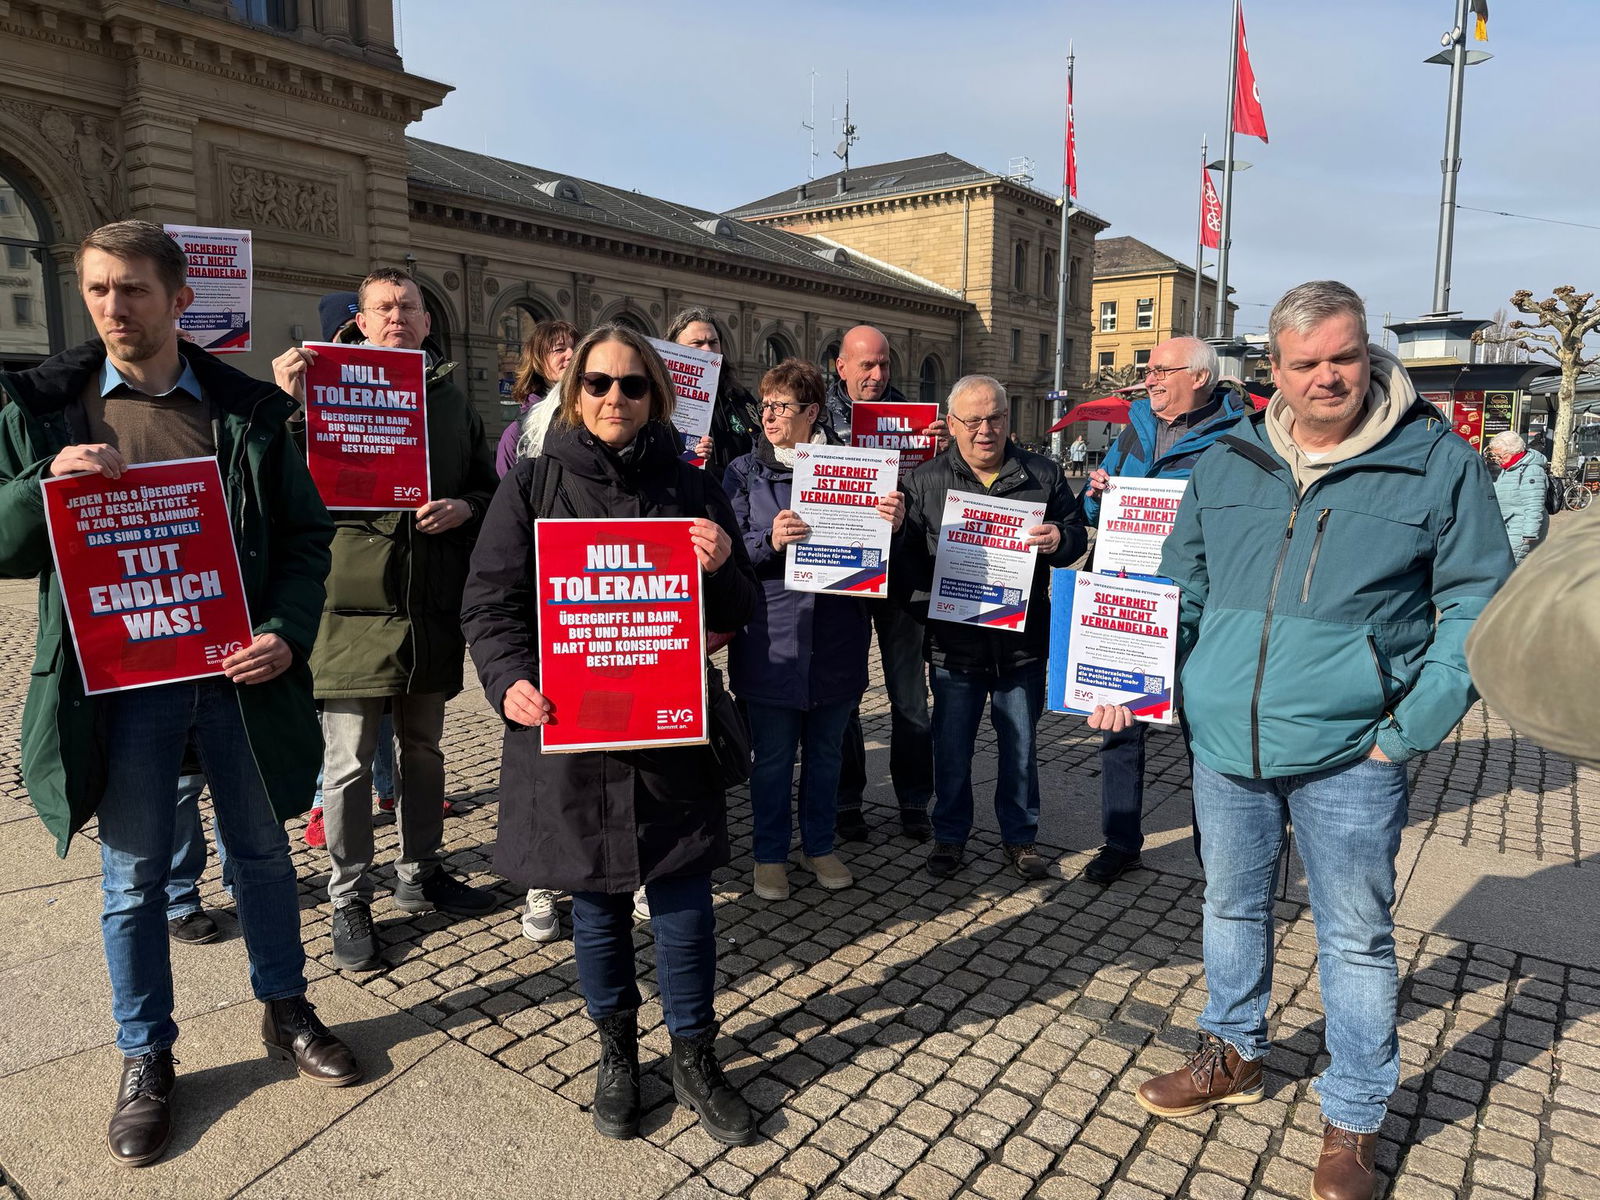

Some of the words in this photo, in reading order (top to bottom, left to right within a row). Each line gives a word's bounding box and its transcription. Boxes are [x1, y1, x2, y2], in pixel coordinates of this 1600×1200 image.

[184, 243, 237, 254] SICHERHEIT
[189, 255, 204, 264] IST
[208, 256, 234, 266] NICHT
[189, 267, 246, 278] RHANDELBAR
[664, 359, 704, 376] HERHEIT
[341, 365, 390, 385] NULL
[672, 373, 699, 387] NICHT
[313, 386, 417, 409] TOLERANZ!
[675, 386, 709, 401] DELBAR
[321, 410, 373, 423] ÜBERGRIFFE
[376, 416, 384, 424] IN
[387, 416, 412, 426] BAHN,
[877, 417, 912, 431] NULL
[328, 423, 345, 432] BUS
[348, 424, 365, 433] UND
[368, 425, 406, 435] BAHNHOF
[317, 433, 340, 442] HART
[343, 434, 360, 443] UND
[363, 435, 418, 445] KONSEQUENT
[857, 435, 930, 449] TOLERANZ!
[342, 444, 394, 454] BESTRAFEN!
[814, 464, 879, 478] SICHERHEIT
[394, 487, 421, 496] EVG
[818, 478, 836, 489] IST
[839, 480, 872, 492] NICHT
[66, 494, 102, 509] JEDEN
[105, 491, 127, 503] TAG
[130, 490, 138, 499] 8
[140, 482, 206, 498] ÜBERGRIFFE
[801, 491, 885, 506] VERHANDELBA
[1121, 495, 1181, 509] SICHERHEIT
[80, 506, 102, 518] AUF
[106, 496, 189, 515] BESCHÄFTIGTE
[77, 521, 90, 532] IN
[93, 517, 119, 529] ZUG,
[121, 515, 148, 526] BUS,
[150, 507, 204, 522] BAHNHOF.
[963, 508, 1024, 526] SICHERHEIT
[1124, 509, 1141, 519] IST
[1144, 510, 1176, 522] NICHT
[88, 534, 112, 546] DAS
[114, 529, 141, 542] SIND
[144, 529, 151, 539] 8
[154, 526, 168, 538] ZU
[170, 522, 200, 536] VIEL!
[965, 520, 983, 532] IST
[985, 523, 1017, 538] NICHT
[117, 543, 180, 576] TUT
[587, 544, 652, 570] NULL
[794, 571, 813, 579] EVG
[89, 570, 222, 614] ENDLICH
[549, 575, 689, 602] TOLERANZ!
[958, 582, 993, 591] unterzeichne
[941, 590, 968, 598] Sicherheit
[1095, 592, 1158, 610] SICHERHEIT
[937, 602, 955, 610] EVG
[560, 611, 629, 625] ÜBERGRIFFE
[632, 612, 644, 623] IN
[648, 611, 682, 623] BAHN,
[1098, 605, 1116, 616] IST
[1119, 608, 1152, 622] NICHT
[122, 605, 202, 640] WAS!
[1082, 614, 1168, 637] VERHANDELBAR
[569, 627, 592, 639] BUS
[595, 627, 618, 638] UND
[622, 625, 674, 638] BAHNHOF
[205, 641, 244, 659] EVG
[553, 642, 585, 654] HART
[589, 641, 612, 653] UND
[616, 638, 689, 652] KONSEQUENT
[586, 653, 658, 667] BESTRAFEN!
[1088, 672, 1111, 681] Petition
[1095, 669, 1133, 678] unterzeichne
[1078, 677, 1107, 686] Sicherheit
[1075, 689, 1093, 699] EVG
[657, 709, 693, 723] EVG
